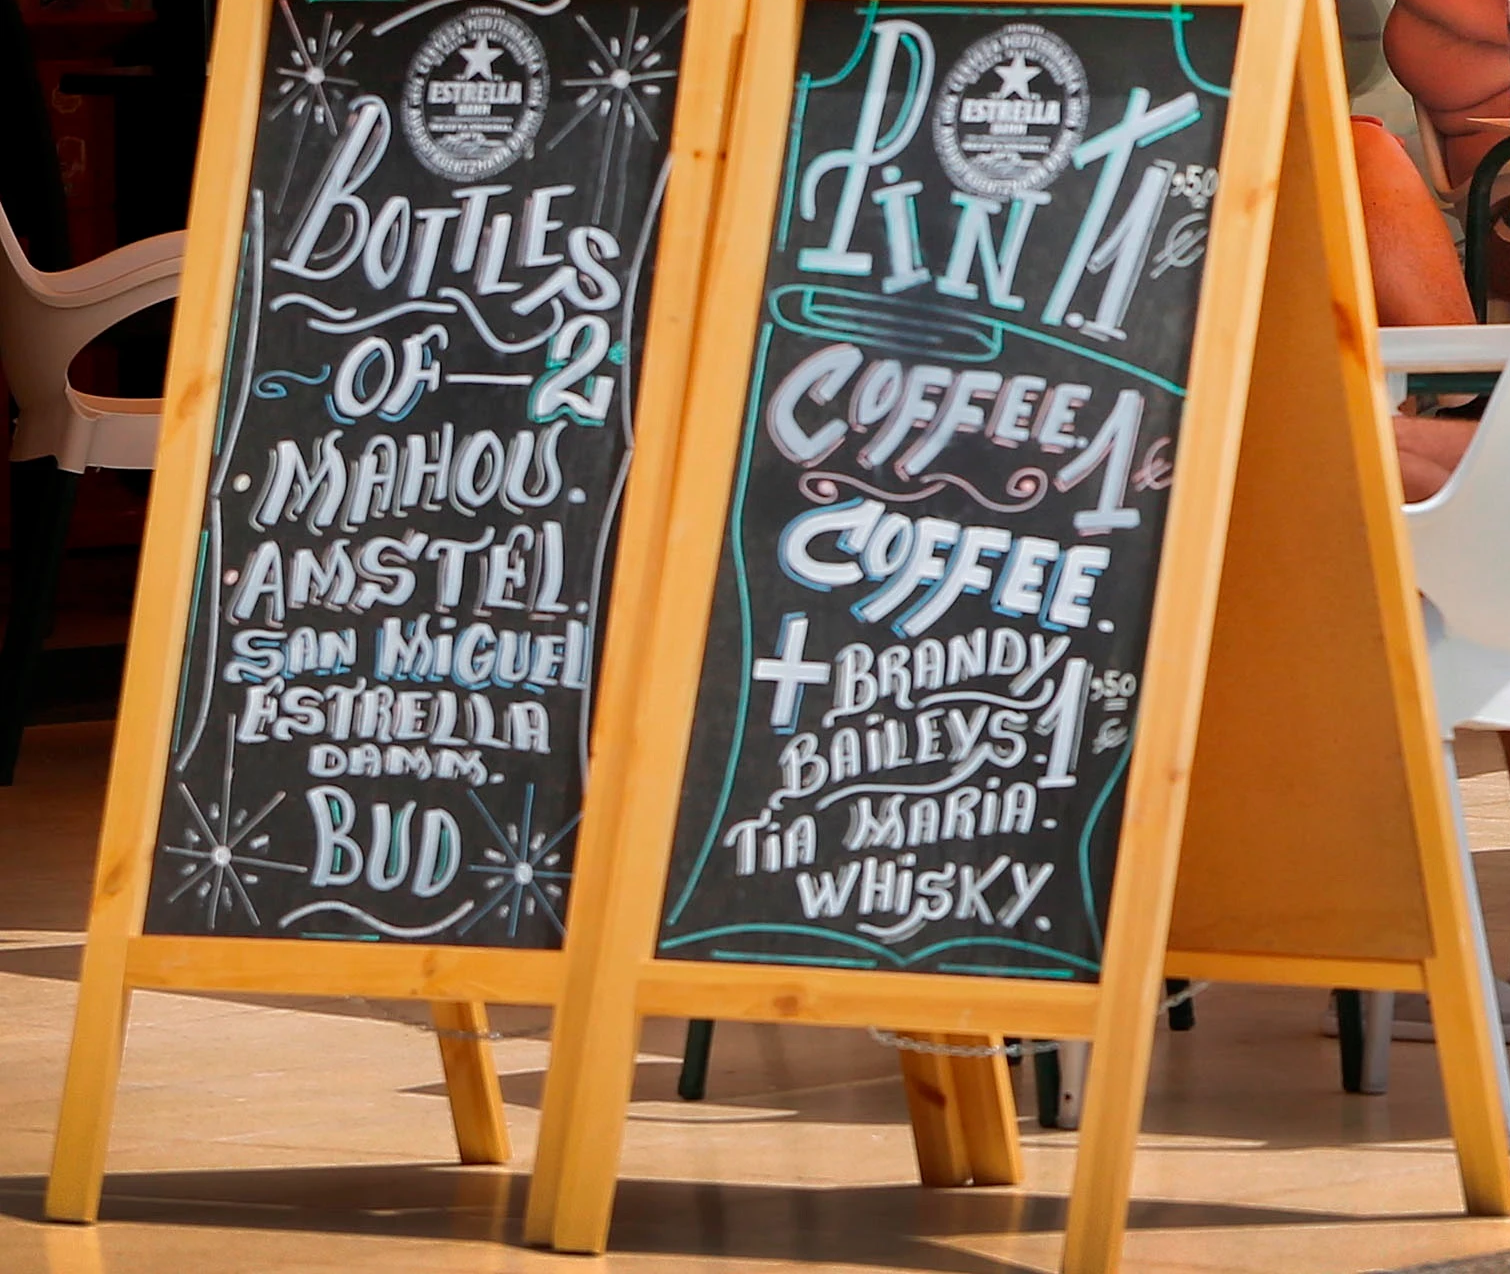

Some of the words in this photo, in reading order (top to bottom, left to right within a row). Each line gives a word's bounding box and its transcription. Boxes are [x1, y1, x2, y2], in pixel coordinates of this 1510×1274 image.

[427, 81, 523, 105] ESTRELLA
[271, 93, 622, 314] BOTTLES
[327, 325, 449, 424] OF
[528, 314, 616, 426] 2
[223, 626, 357, 684] SAN
[823, 627, 1071, 727] BRANDY
[236, 677, 551, 754] ESTRELLA
[306, 785, 462, 898] BUD
